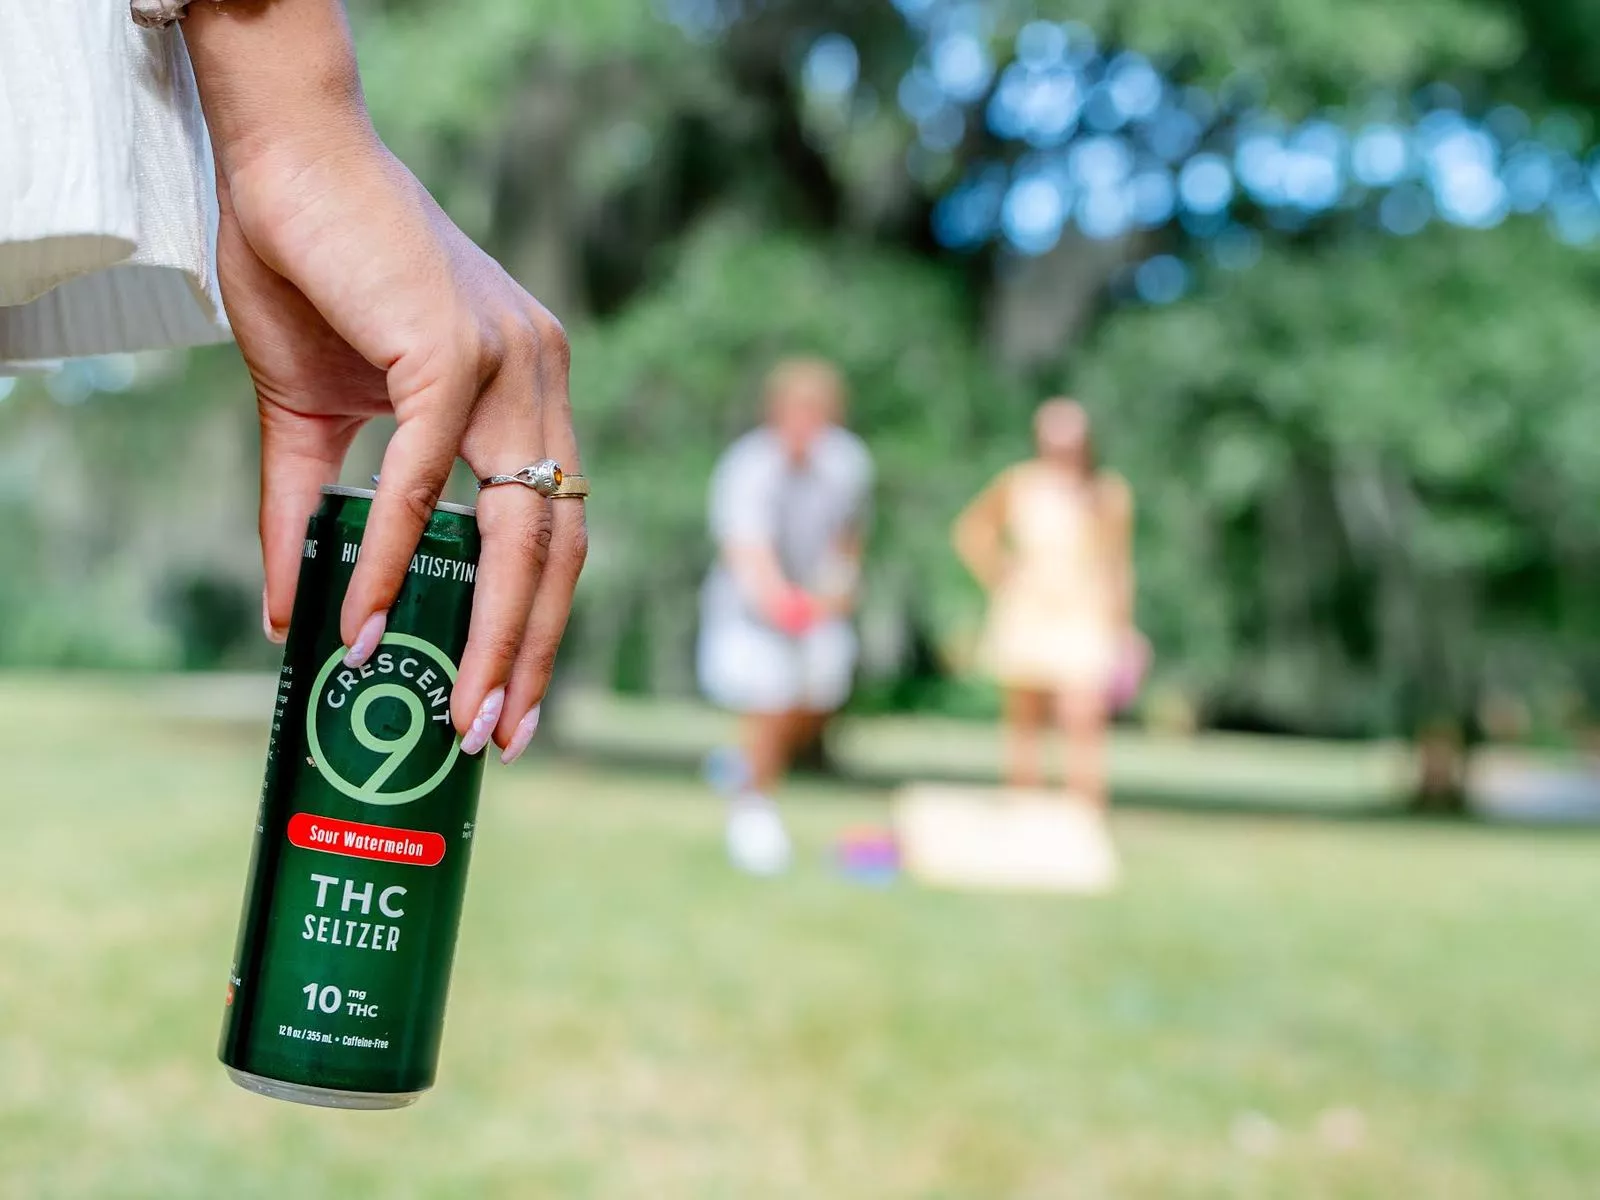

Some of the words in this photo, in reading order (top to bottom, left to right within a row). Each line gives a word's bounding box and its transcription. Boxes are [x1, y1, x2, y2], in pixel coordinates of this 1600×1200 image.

[341, 542, 361, 563] HI
[408, 553, 478, 583] ATISFYIN
[327, 653, 451, 725] CRESCENT
[351, 683, 426, 797] 9
[309, 825, 340, 845] Sour
[343, 831, 424, 857] Watermelon
[310, 873, 408, 918] THC
[302, 914, 401, 951] SELTZER
[302, 982, 342, 1014] 10
[348, 989, 367, 1000] mg
[346, 1002, 379, 1018] THC
[278, 1024, 286, 1036] 12
[286, 1026, 293, 1037] fl
[292, 1029, 301, 1039] oz
[306, 1030, 321, 1042] 355
[321, 1033, 333, 1044] mL
[342, 1035, 389, 1049] Caffeine-Free
